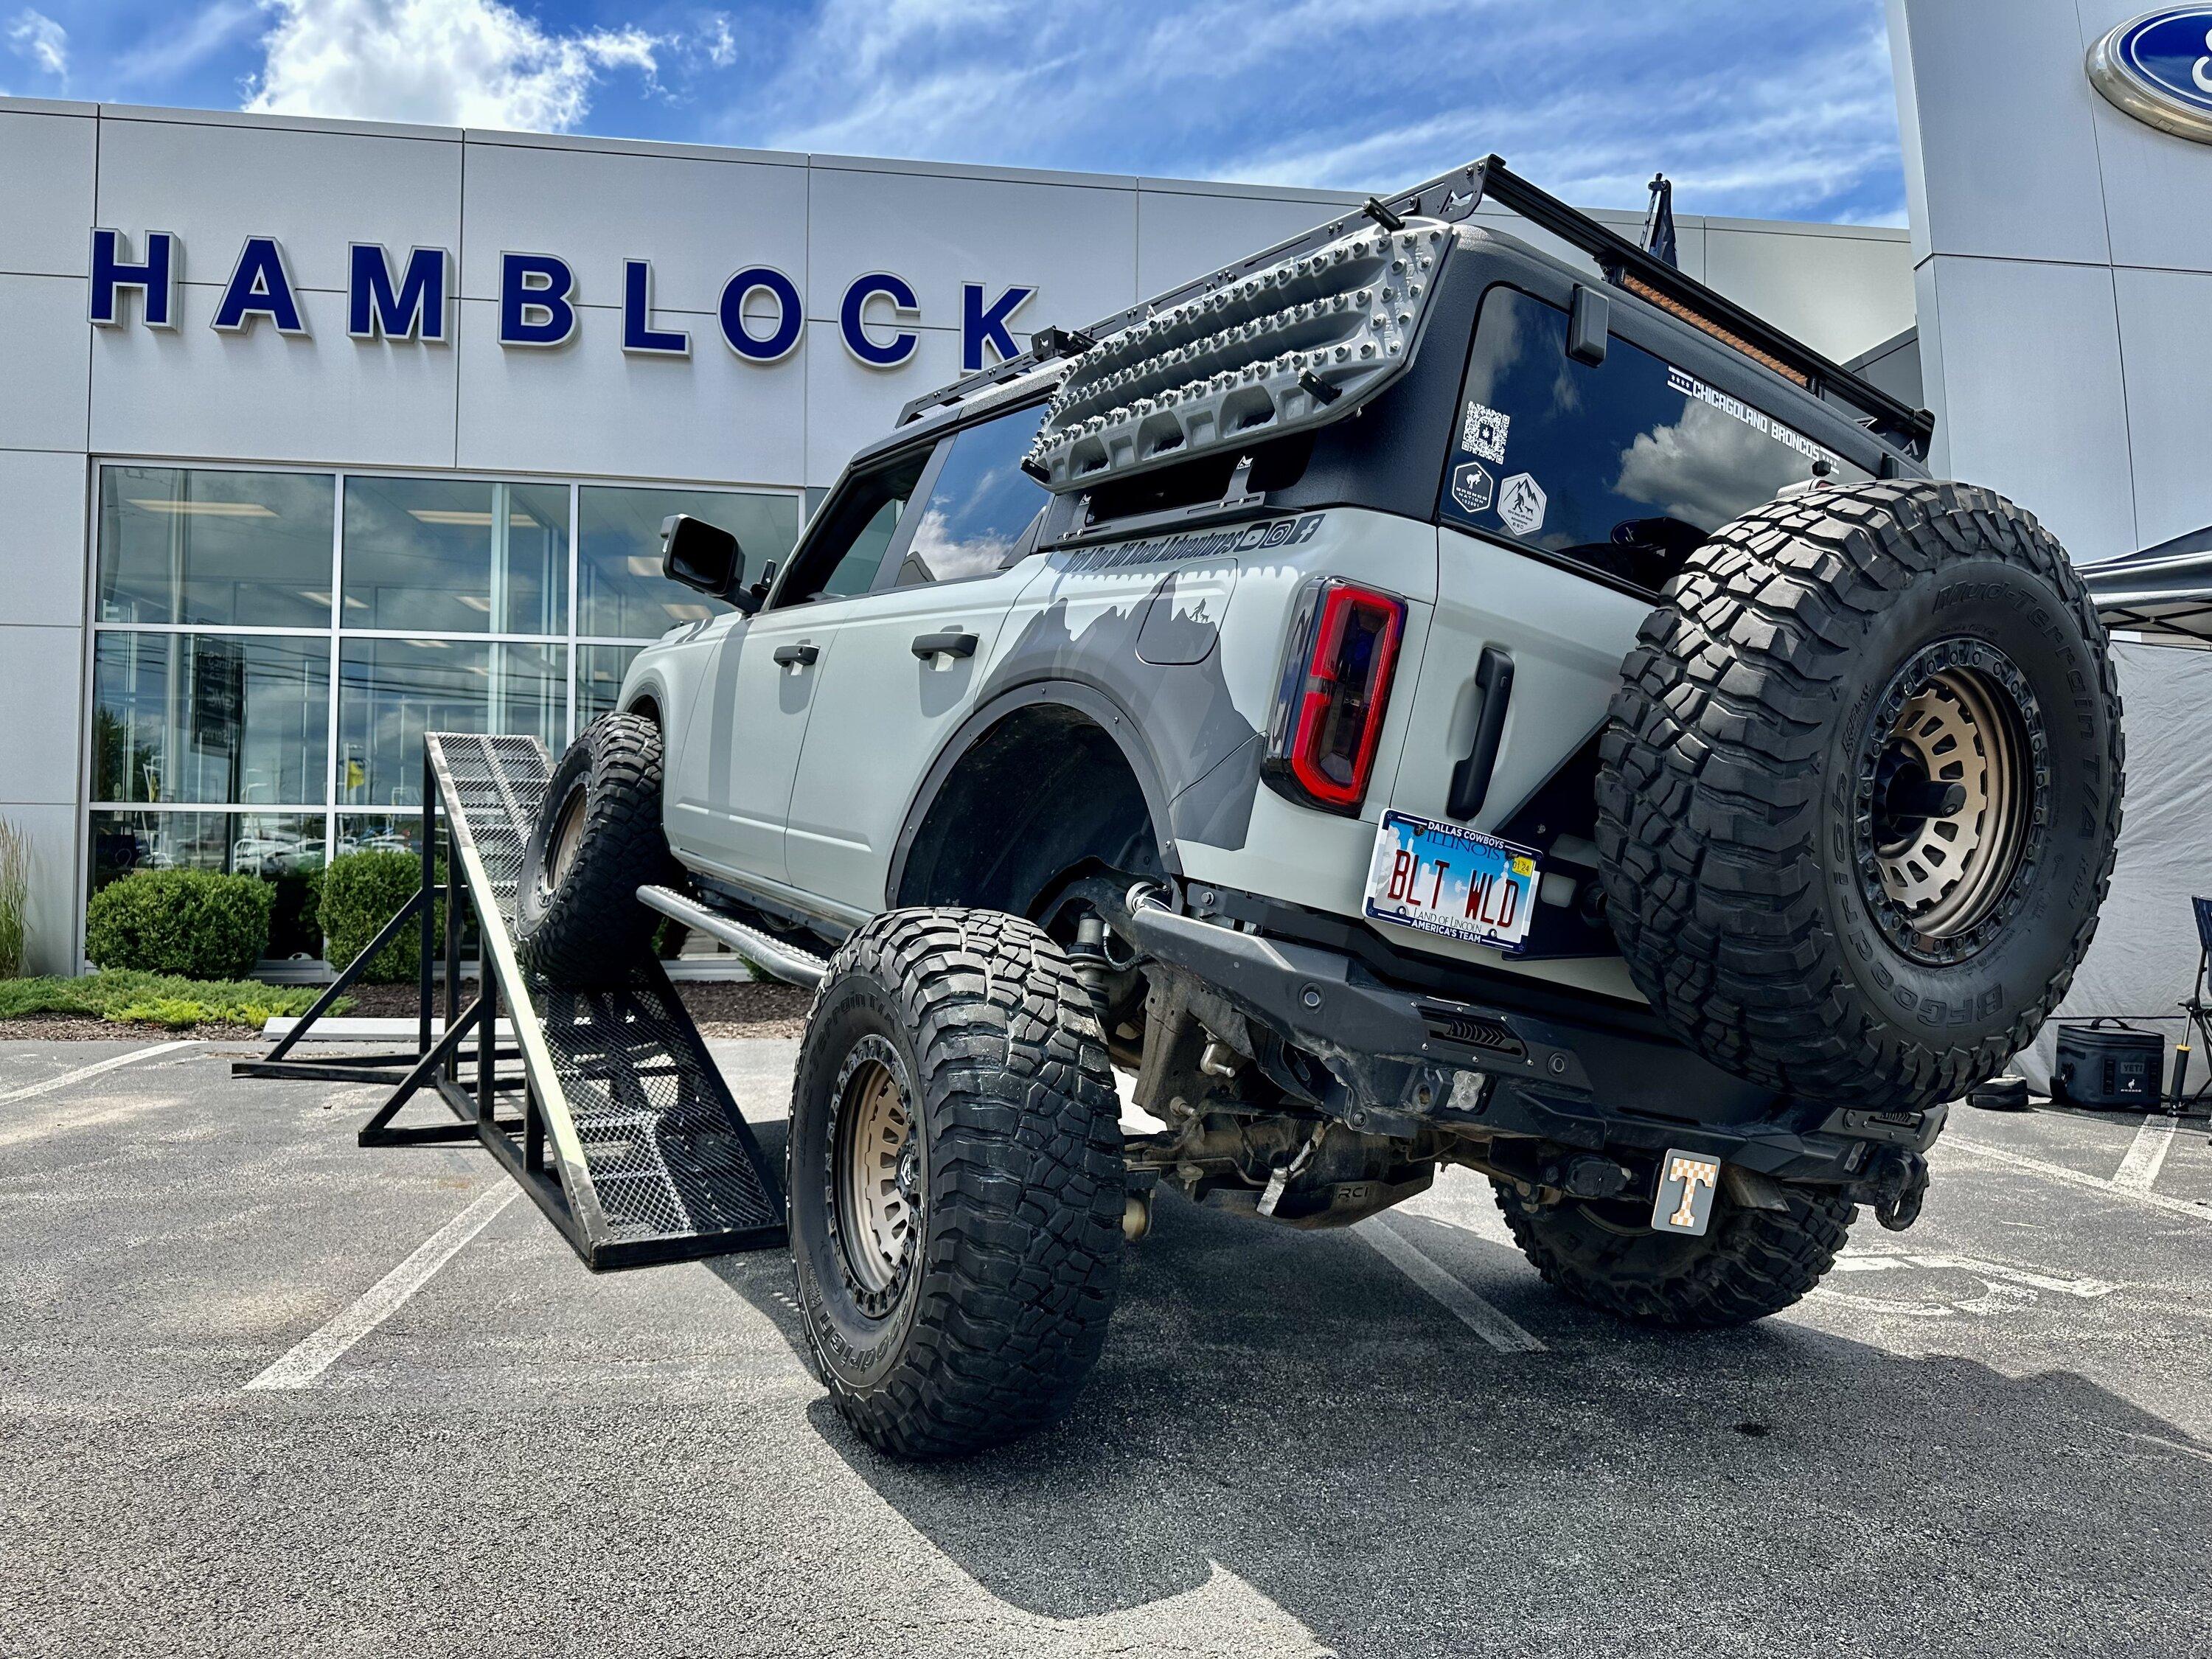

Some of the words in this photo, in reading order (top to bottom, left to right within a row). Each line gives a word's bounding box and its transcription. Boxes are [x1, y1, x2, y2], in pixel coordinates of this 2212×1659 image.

[88, 226, 1040, 374] HAMBLOCK
[1692, 380, 1768, 434] CHICAGOLAND
[1771, 420, 1820, 461] BRONCOS
[1458, 493, 1484, 504] NATION
[1058, 548, 1096, 574] Bird
[1081, 547, 1116, 571] Dog
[1105, 542, 1138, 568] Off
[1121, 538, 1171, 566] Road
[1153, 531, 1244, 563] Adventures
[1932, 580, 2094, 740] Mud-Terrain
[2079, 754, 2100, 839] T/A
[1427, 832, 1500, 860] ILLINOIS
[1428, 821, 1462, 838] DALLAS
[1464, 830, 1505, 849] COWBOYS
[1387, 849, 1450, 910] BLT
[1465, 869, 1519, 928] WLD
[1832, 772, 2003, 1028] BFGoodrich
[1411, 919, 1456, 938] AMERICA'S
[1459, 928, 1481, 943] TEAM
[1413, 907, 1436, 922] LAND
[1438, 914, 1449, 924] OF
[1450, 917, 1482, 933] LINCOLN
[1338, 1187, 1368, 1199] RCI
[1669, 1158, 1717, 1228] T
